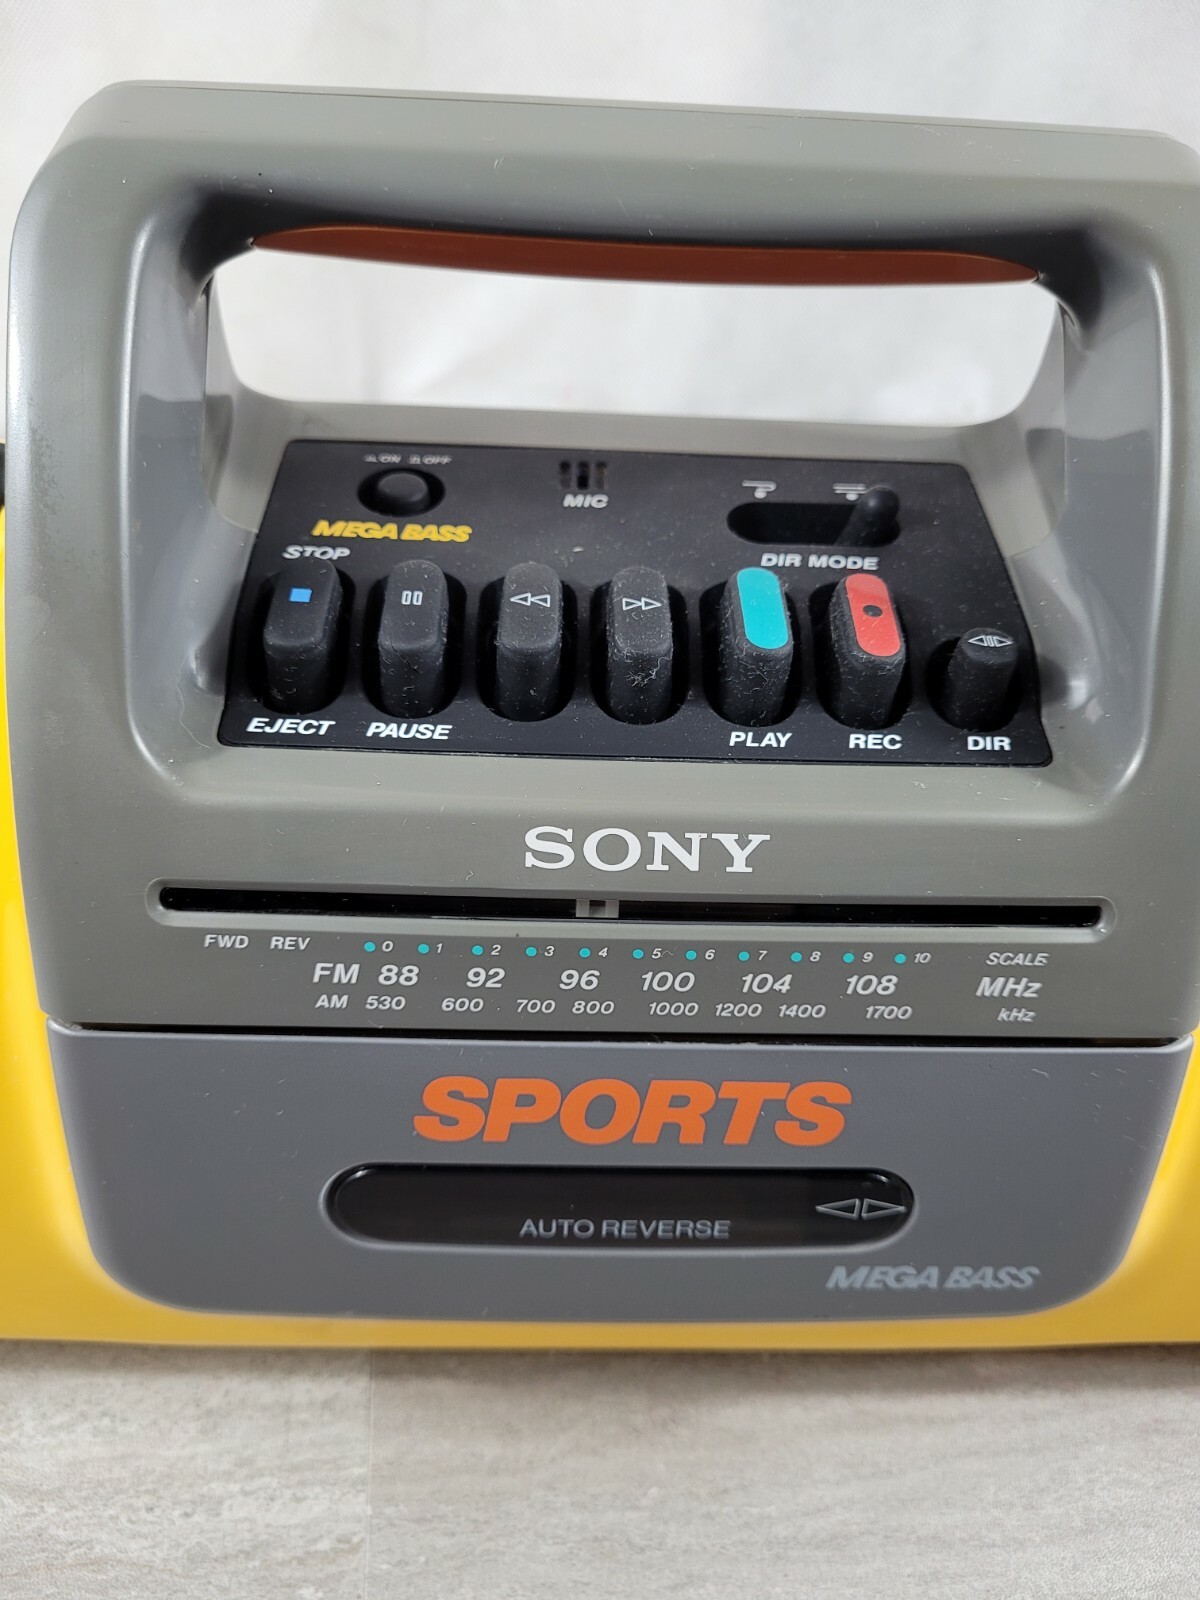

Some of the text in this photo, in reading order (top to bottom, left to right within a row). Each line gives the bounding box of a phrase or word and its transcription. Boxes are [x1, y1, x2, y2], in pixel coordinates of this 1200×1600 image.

[562, 494, 609, 509] MIC
[311, 520, 473, 543] MEGA BASS
[282, 545, 351, 561] STOP
[760, 552, 880, 571] DIR MODE
[246, 717, 336, 736] EJECT
[365, 722, 453, 740] PAUSE
[728, 731, 792, 748] PLAY
[849, 733, 902, 750] REC
[967, 736, 1011, 751] DIR
[524, 826, 771, 873] SONY
[203, 934, 249, 949] FWD
[269, 936, 311, 950] REV
[381, 941, 931, 963] 0 1 2 3 4 5 6 7 8 9 10
[985, 952, 1049, 967] SCALE
[312, 962, 1042, 998] FM 88 92 96 100 104 108 MHz
[315, 995, 1036, 1023] AM 530 600 700 800 1000 1200 1400 1700 kHz
[413, 1075, 853, 1147] SPORTS
[519, 1219, 731, 1240] AUTO REVERSE
[825, 1265, 1040, 1291] MEGA BASS
